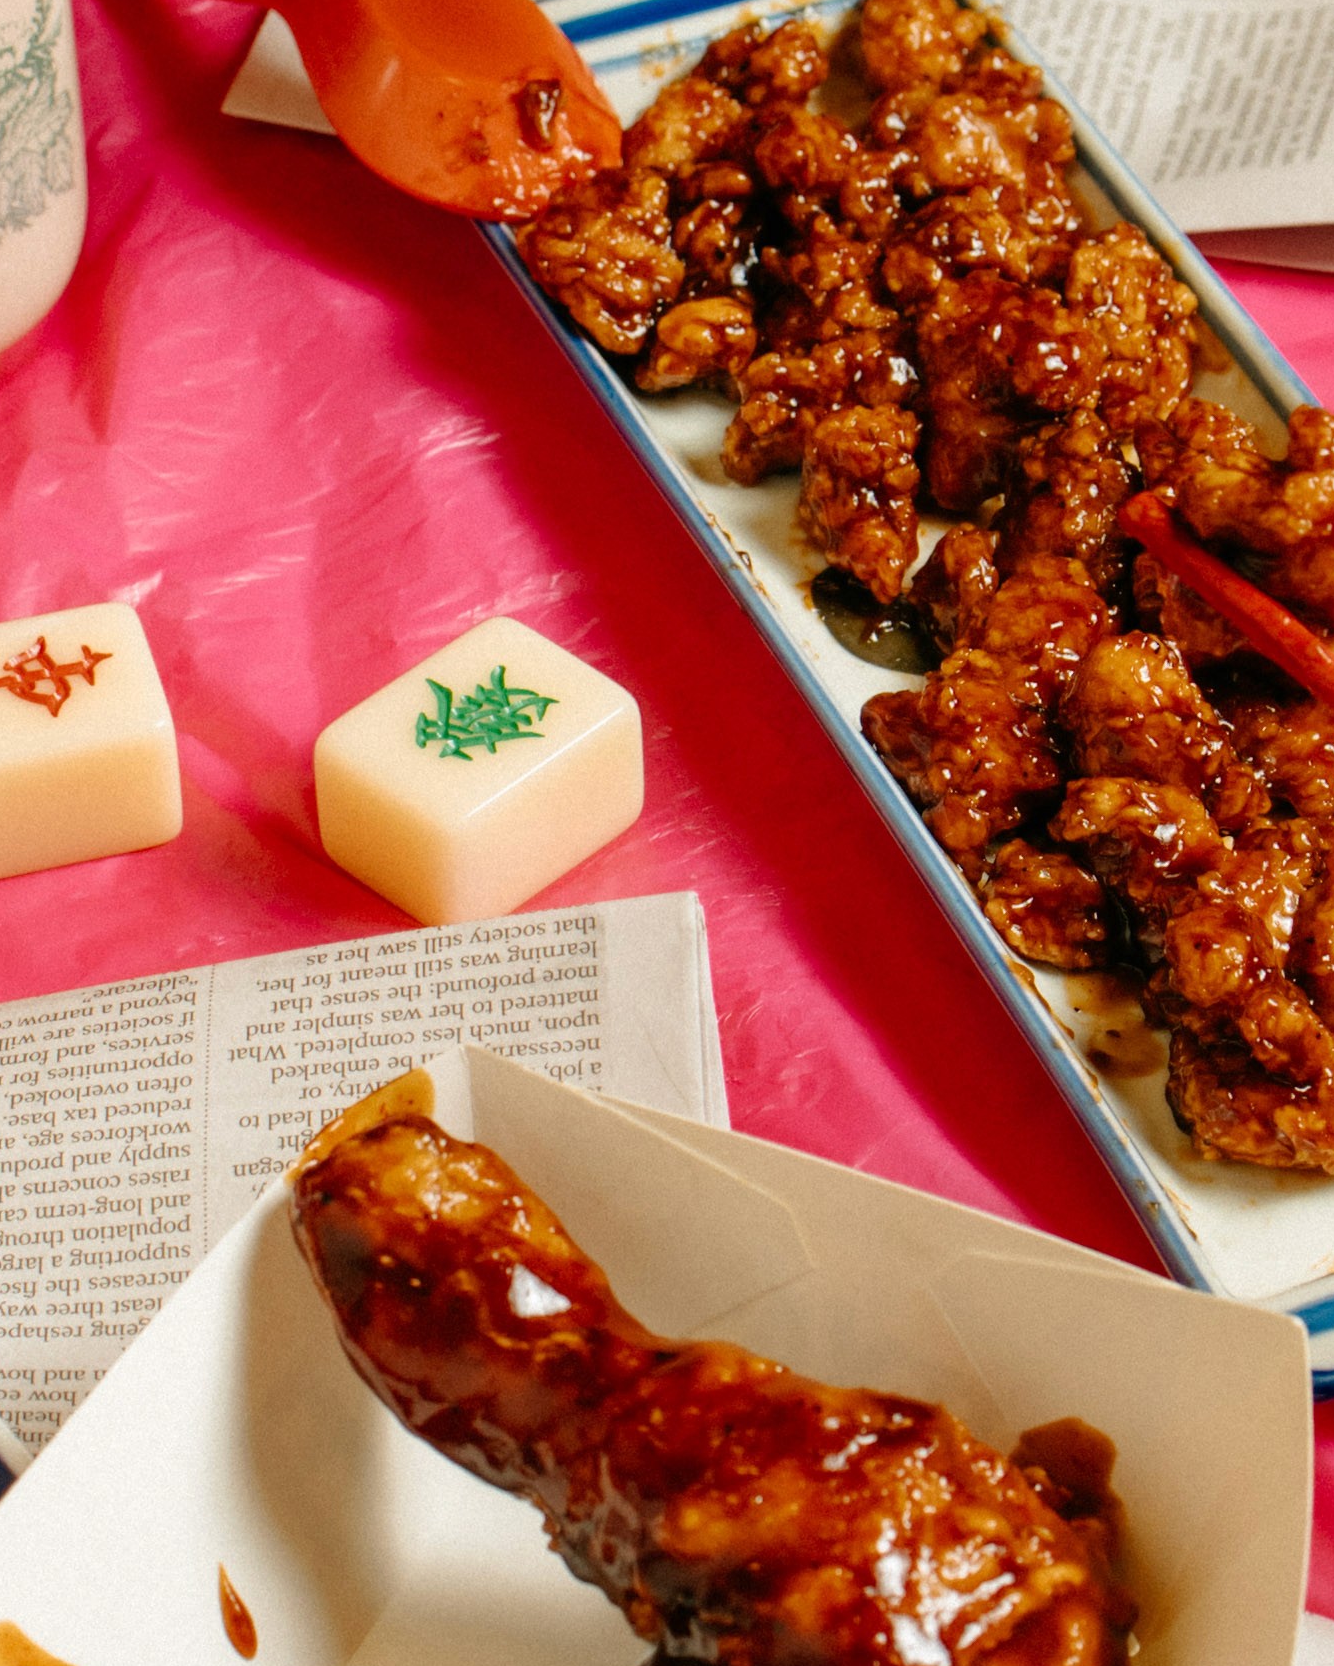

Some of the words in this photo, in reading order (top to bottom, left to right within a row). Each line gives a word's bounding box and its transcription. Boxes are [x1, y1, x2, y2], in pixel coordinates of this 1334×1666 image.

[469, 923, 546, 944] society
[554, 915, 596, 935] that
[377, 940, 416, 956] saw
[424, 934, 462, 955] still
[507, 941, 597, 963] learning
[306, 953, 328, 966] as
[334, 947, 369, 963] her
[460, 953, 501, 968] was
[339, 964, 406, 983] meant
[414, 958, 452, 978] still
[543, 965, 598, 982] more
[256, 978, 294, 993] her,
[302, 974, 331, 989] for
[430, 967, 535, 999] profound:
[321, 989, 379, 1006] sense
[387, 985, 421, 1002] the
[500, 989, 598, 1016] mattered
[102, 1004, 112, 1014] a
[119, 991, 196, 1016] beyond
[270, 997, 312, 1014] that
[428, 1003, 464, 1020] her
[471, 1000, 492, 1014] to
[20, 1007, 93, 1027] narrow
[82, 1014, 173, 1035] societies
[178, 1011, 194, 1027] if
[292, 1012, 373, 1034] simpler
[381, 1008, 421, 1023] was
[538, 1010, 600, 1030] upon,
[43, 1028, 75, 1041] are
[246, 1022, 285, 1041] and
[422, 1027, 461, 1044] less
[470, 1020, 529, 1042] much
[102, 1031, 194, 1052] services,
[294, 1031, 414, 1059] completed.
[56, 1044, 95, 1063] and
[227, 1045, 286, 1063] What
[47, 1051, 193, 1080] opportunities
[271, 1058, 379, 1085] embarked
[387, 1055, 413, 1074] be
[544, 1059, 582, 1079] job,
[590, 1062, 602, 1075] a
[9, 1071, 39, 1086] for
[136, 1076, 192, 1094] often
[4, 1082, 129, 1110] overlooked,
[298, 1087, 321, 1100] or
[3, 1112, 55, 1127] base.
[64, 1107, 96, 1121] tax
[104, 1098, 191, 1122] reduced
[238, 1115, 259, 1129] to
[268, 1110, 311, 1131] lead
[23, 1130, 64, 1147] age,
[71, 1122, 191, 1143] workforces
[72, 1152, 111, 1172] and
[118, 1142, 191, 1167] supply
[22, 1175, 121, 1196] concerns
[128, 1169, 190, 1186] raises
[35, 1196, 141, 1219] long-term
[150, 1194, 191, 1215] and
[71, 1214, 191, 1242] population
[51, 1256, 62, 1268] a
[69, 1242, 191, 1267] supporting
[45, 1279, 79, 1296] the
[87, 1270, 189, 1290] increases
[46, 1302, 103, 1319] three
[111, 1297, 161, 1314] least
[43, 1370, 85, 1385] and
[27, 1390, 76, 1404] how
